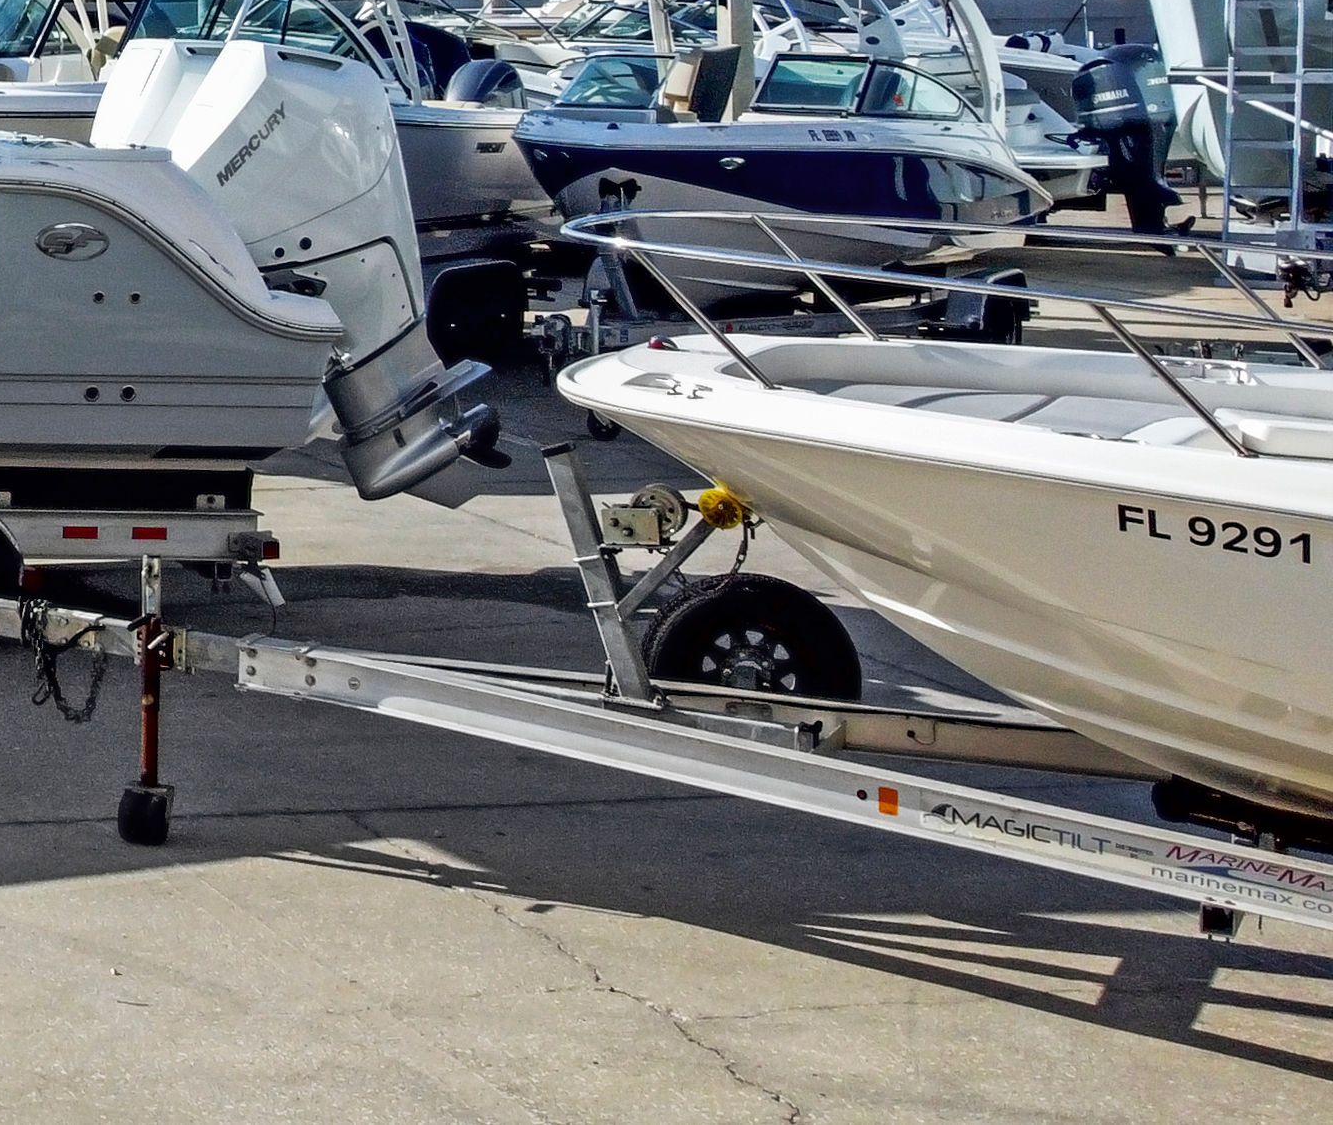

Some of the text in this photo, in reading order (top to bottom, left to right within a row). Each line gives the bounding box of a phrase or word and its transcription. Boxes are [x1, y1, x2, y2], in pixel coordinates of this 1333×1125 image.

[216, 100, 286, 187] MERCURY
[1118, 504, 1311, 564] FL 9291
[951, 807, 1111, 855] MAGICTILT
[1166, 845, 1333, 892] MARINEMA
